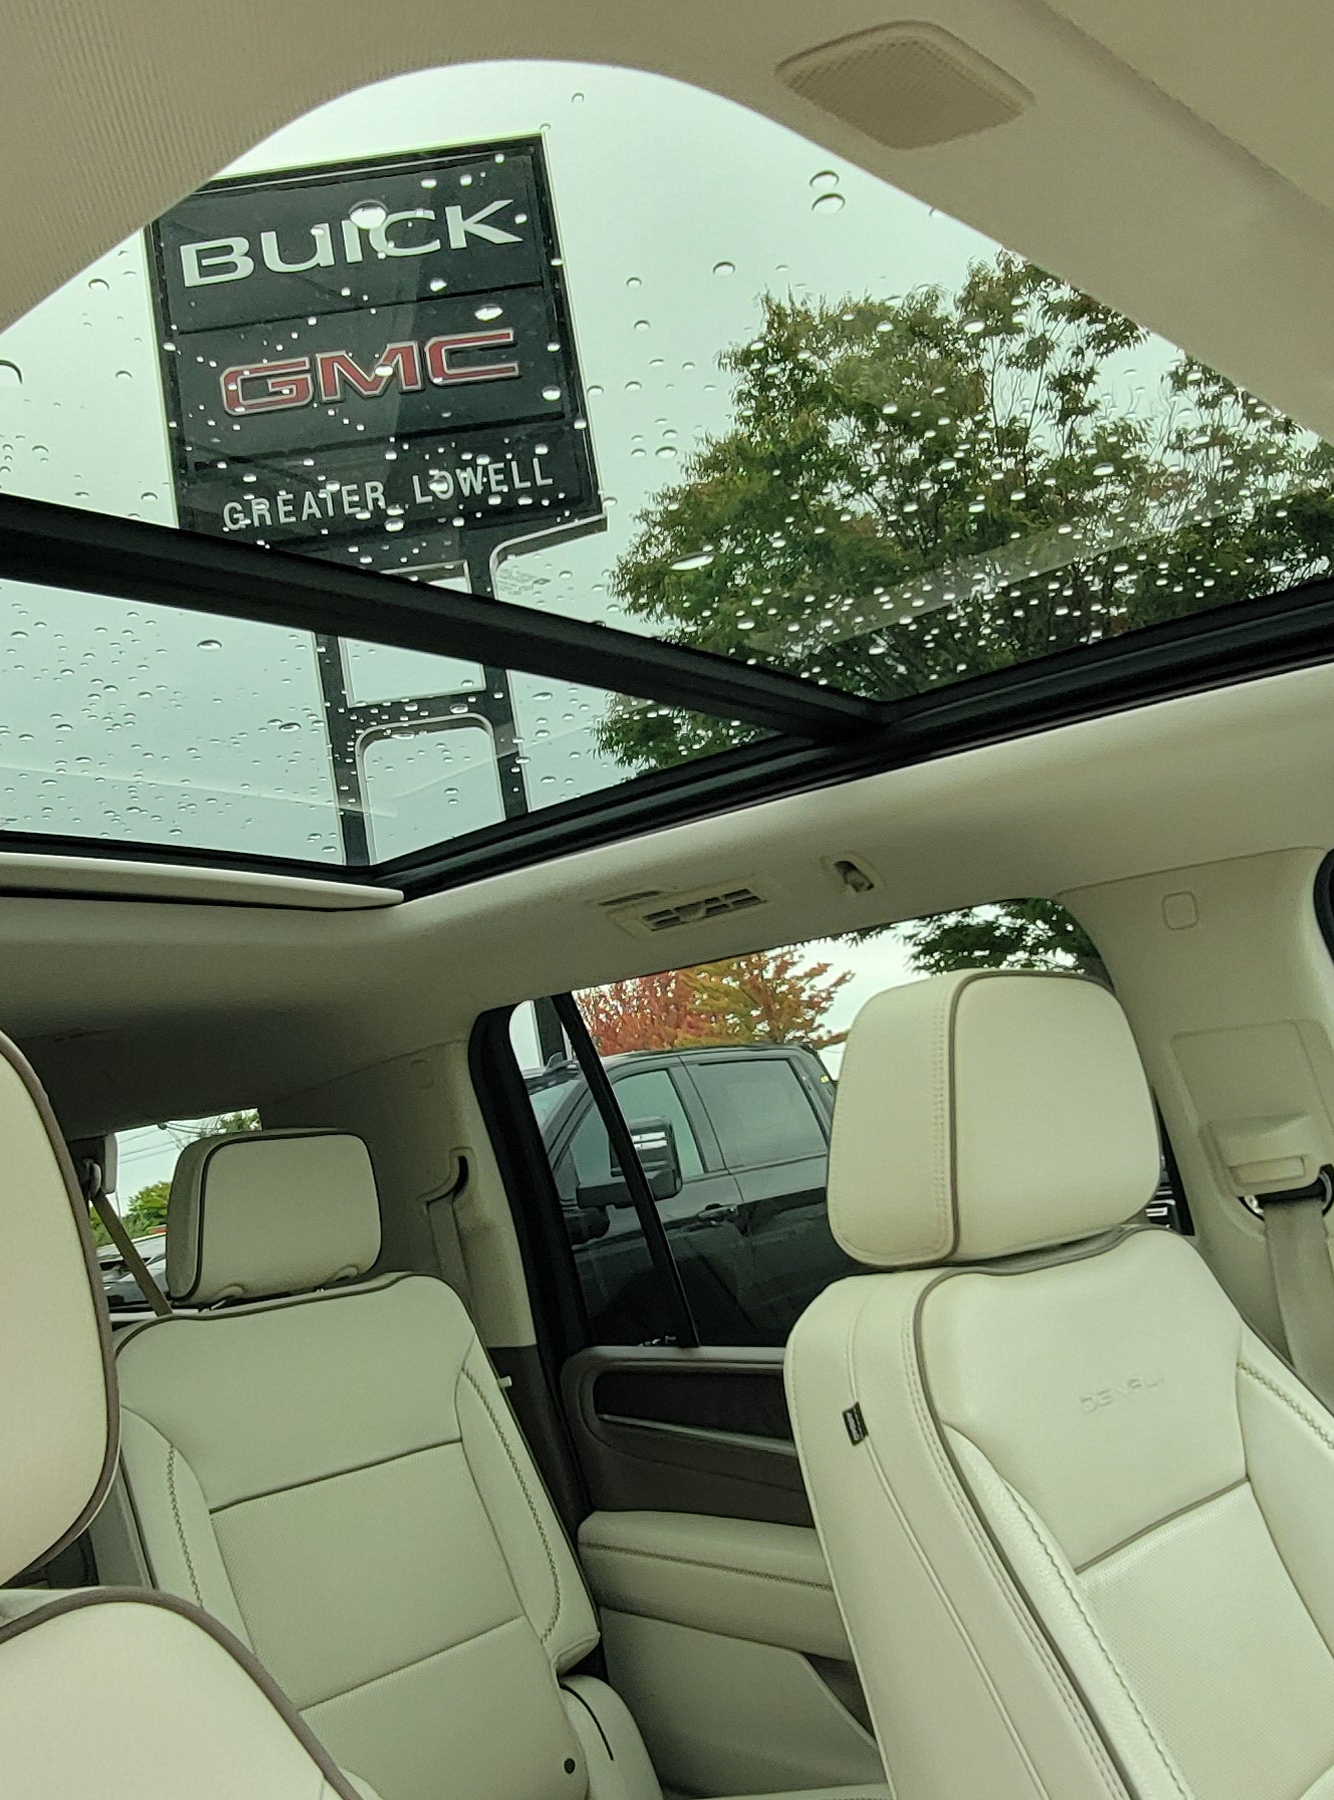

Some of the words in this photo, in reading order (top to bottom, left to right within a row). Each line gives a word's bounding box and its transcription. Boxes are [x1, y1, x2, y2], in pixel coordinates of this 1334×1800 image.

[180, 199, 523, 288] BUICK
[220, 327, 519, 416] GMC
[223, 480, 386, 531] GREATER
[412, 457, 553, 504] LOWELL
